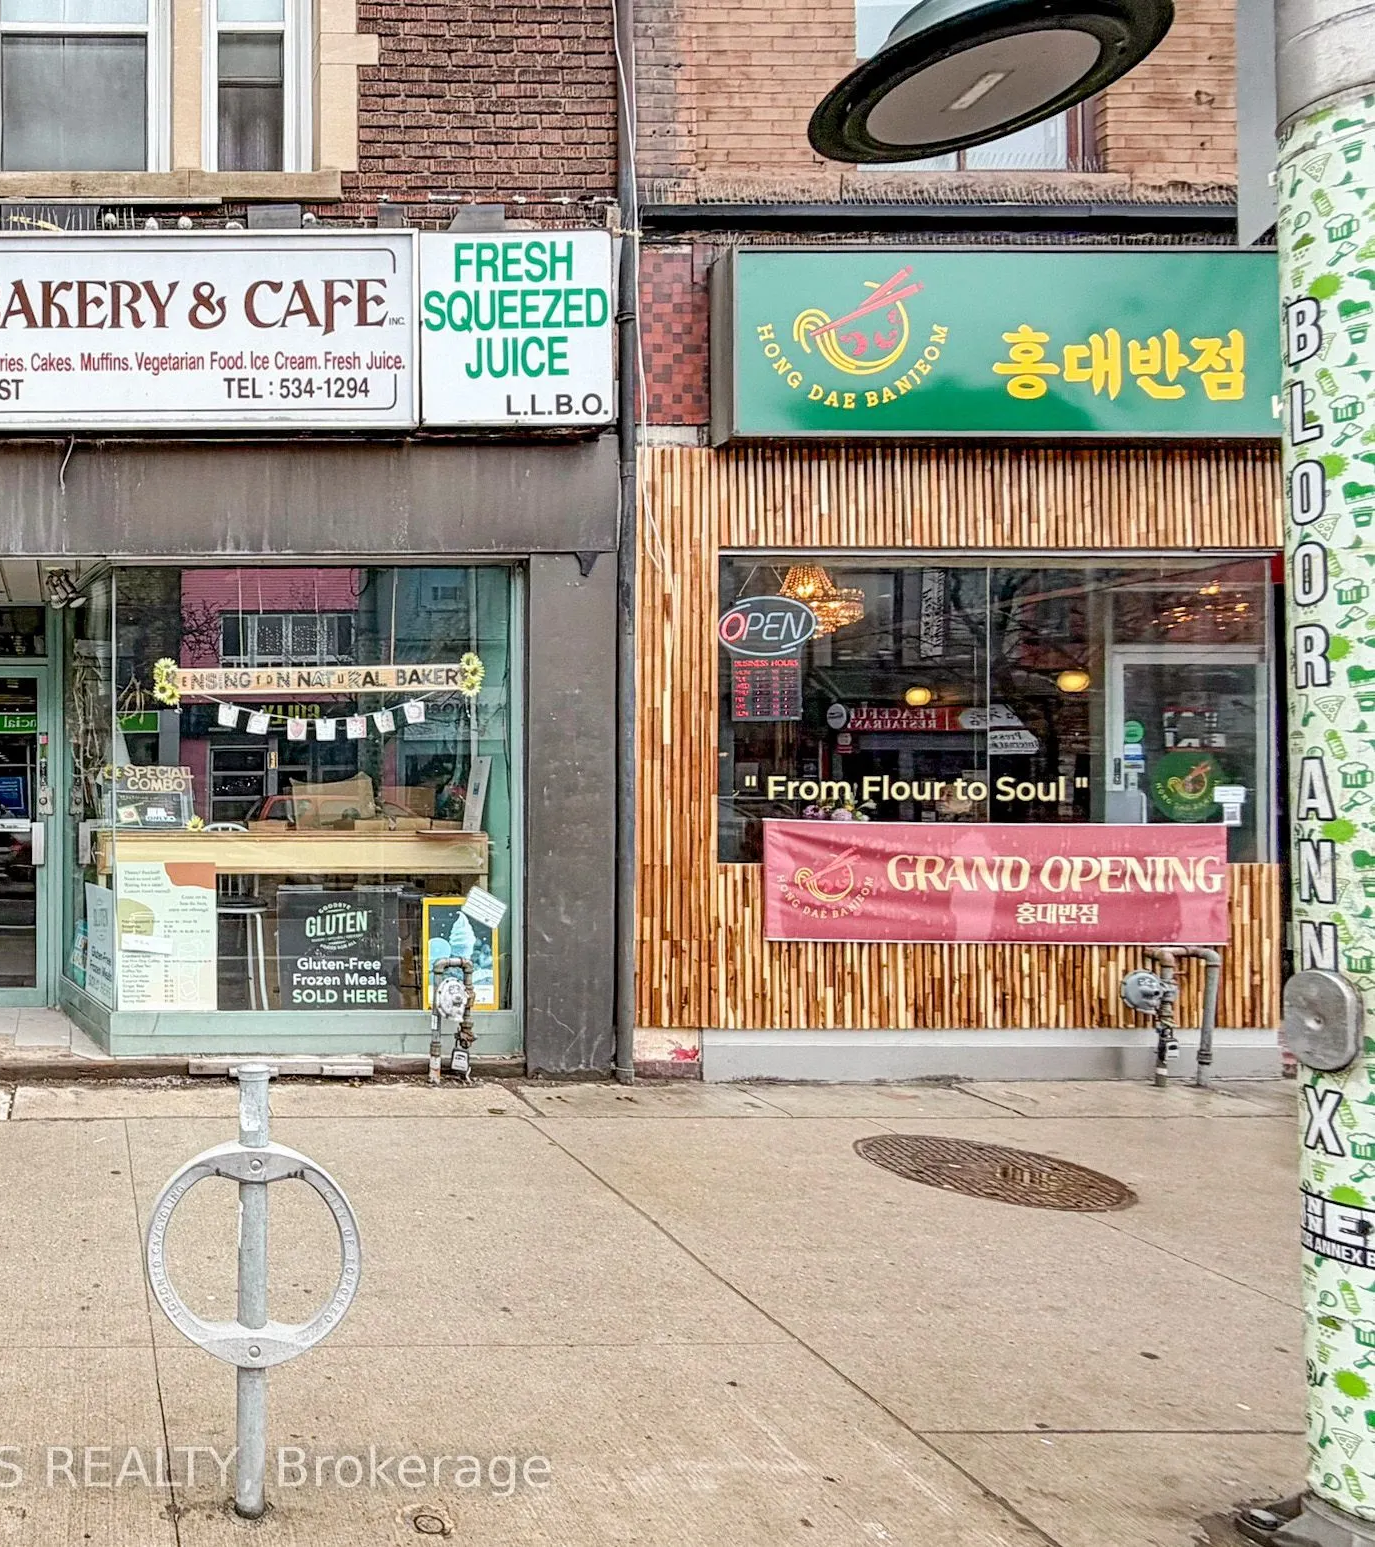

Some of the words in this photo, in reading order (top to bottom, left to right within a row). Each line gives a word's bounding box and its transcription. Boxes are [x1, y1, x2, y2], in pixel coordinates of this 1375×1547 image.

[454, 240, 574, 283] FRESH
[187, 281, 227, 330] &
[243, 277, 389, 337] CAFE
[424, 287, 608, 333] SQUEEZED
[30, 353, 75, 372] Cakes.
[80, 352, 133, 372] Muffins.
[135, 352, 205, 376] Vegetarian
[210, 352, 247, 372] Food.
[250, 352, 270, 371] Ice
[274, 351, 322, 371] Cream.
[324, 351, 361, 370] Fresh
[365, 350, 406, 371] Juice.
[465, 336, 569, 379] JUICE
[756, 322, 803, 389] HONG
[808, 383, 856, 409] DAE
[864, 323, 950, 408] BANJEOM
[992, 323, 1247, 402] 홍대반점
[223, 378, 263, 398] TEL
[279, 377, 370, 398] 534-1294
[506, 393, 609, 416] L.L.B.O.
[1286, 297, 1331, 690] BLOOR
[723, 612, 806, 643] OPEN
[123, 764, 194, 779] SPECIAL
[127, 777, 185, 791] COMBO
[768, 775, 851, 801] From
[862, 775, 943, 801] Flour
[952, 778, 986, 801] to
[995, 775, 1066, 802] Soul
[887, 856, 1030, 892] GRAND
[1040, 856, 1224, 893] OPENING
[776, 874, 801, 909] HONG
[802, 906, 828, 919] DAE
[305, 911, 368, 938] GLUTEN
[1015, 902, 1099, 925] 홍대반점
[297, 957, 382, 970] Gluten-Free
[1297, 756, 1345, 1158] ANNX
[292, 973, 341, 986] Frozen
[345, 973, 387, 986] Meals
[292, 989, 338, 1003] SOLD
[343, 989, 388, 1003] HERE
